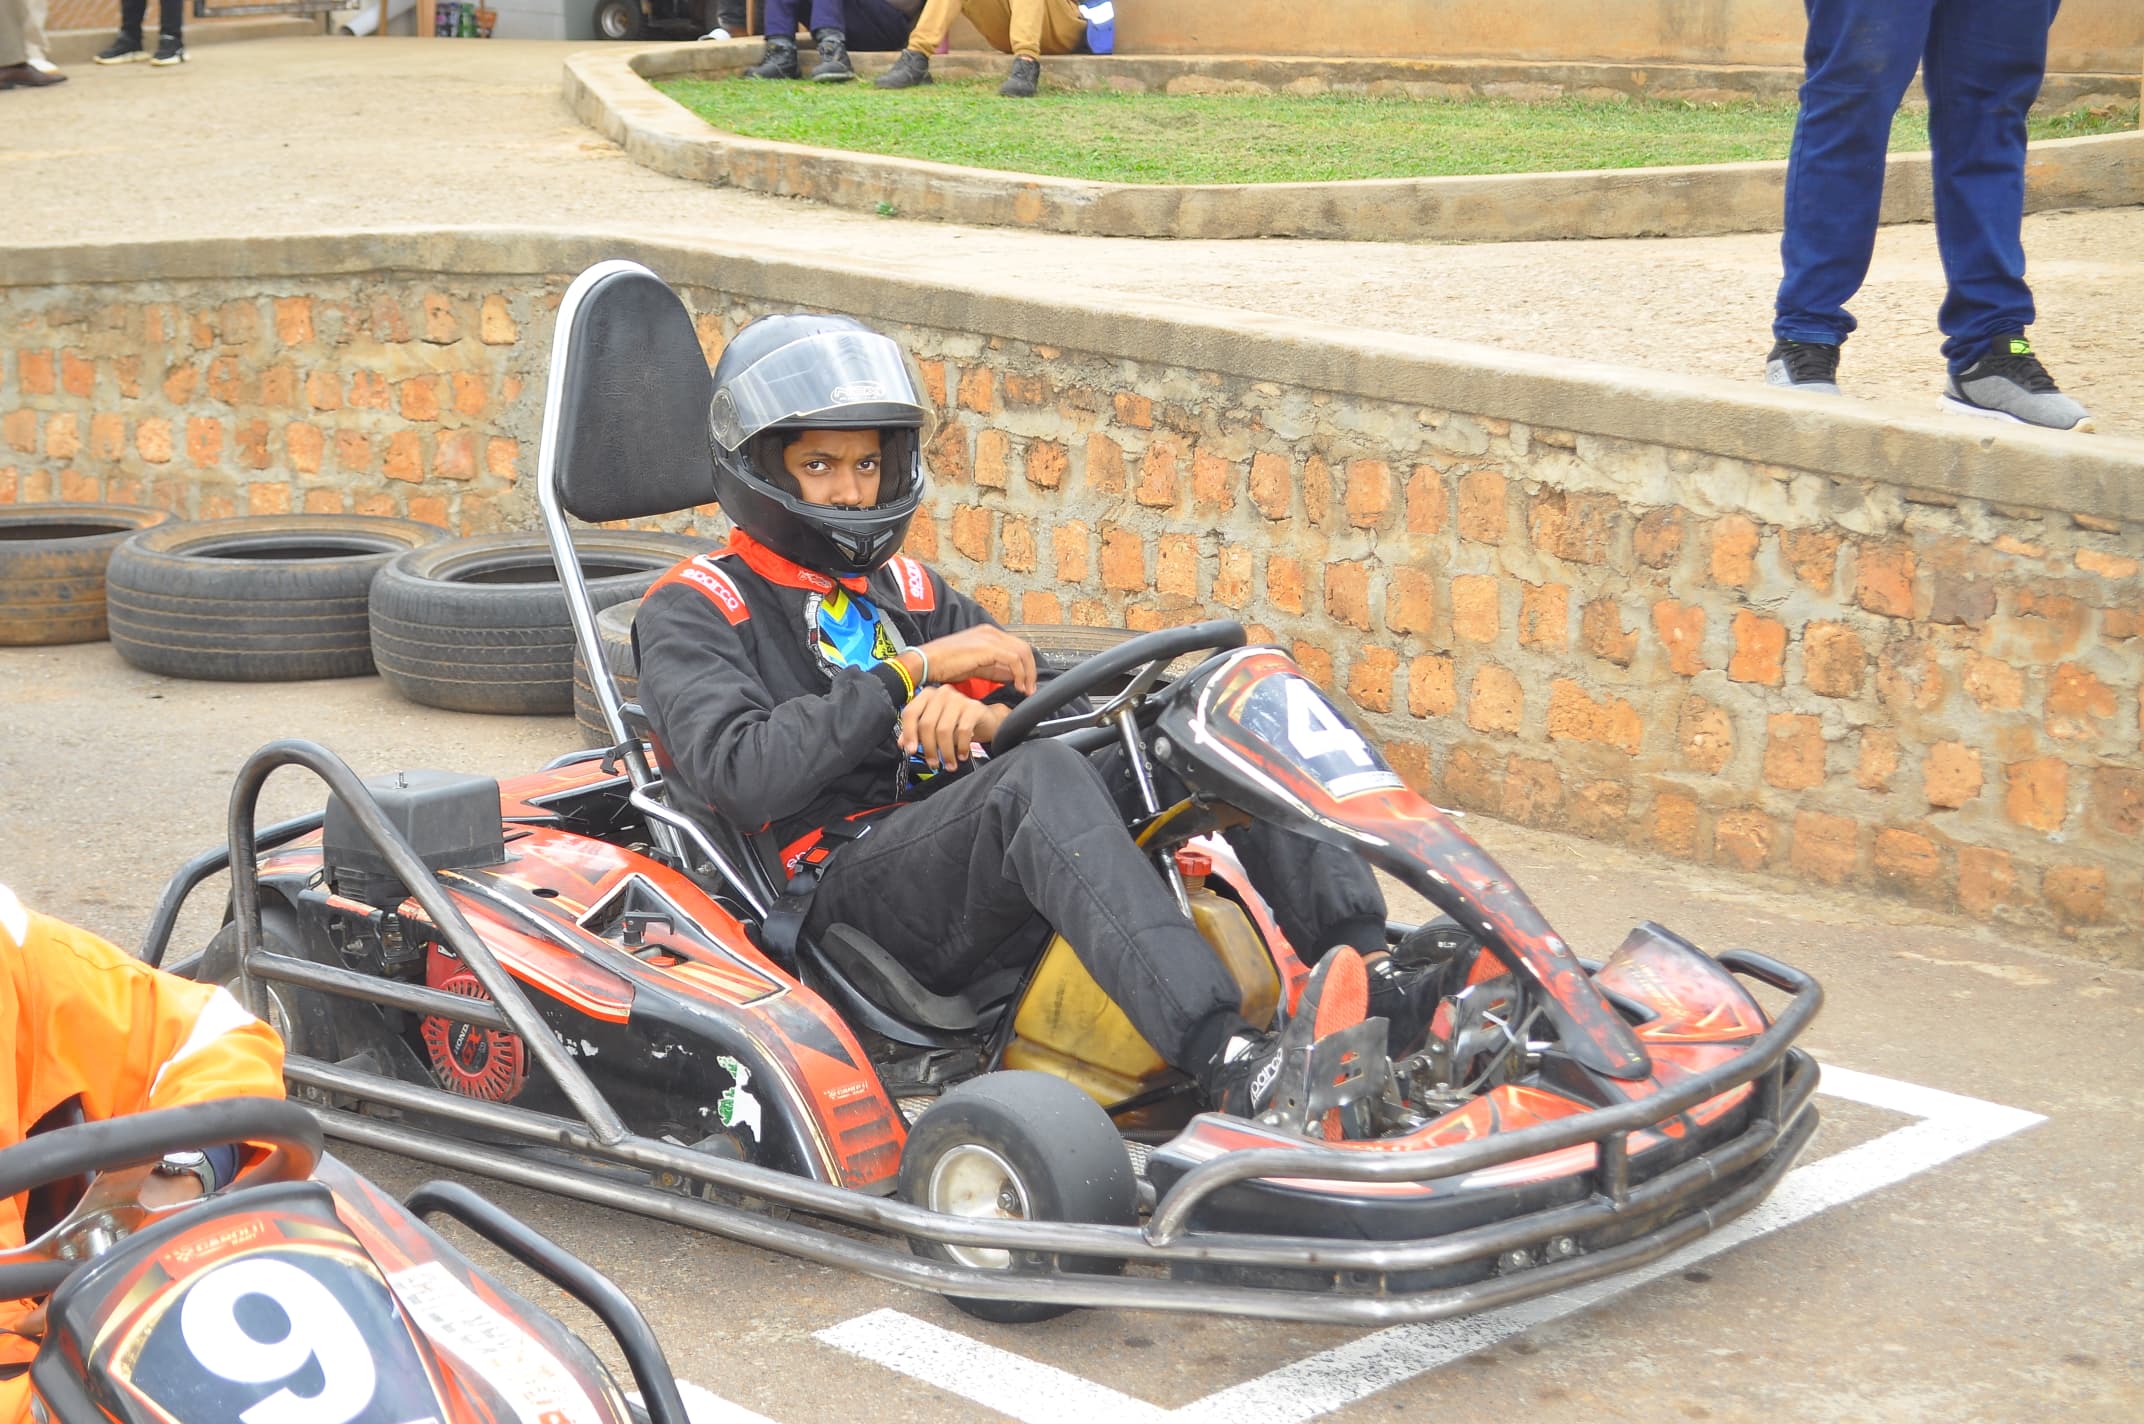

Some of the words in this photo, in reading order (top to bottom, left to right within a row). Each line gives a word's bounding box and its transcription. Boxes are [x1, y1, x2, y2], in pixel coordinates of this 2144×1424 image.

[680, 568, 739, 612] sparco
[1285, 679, 1374, 767] 4
[453, 1023, 470, 1055] HOND
[181, 1258, 376, 1424] 9
